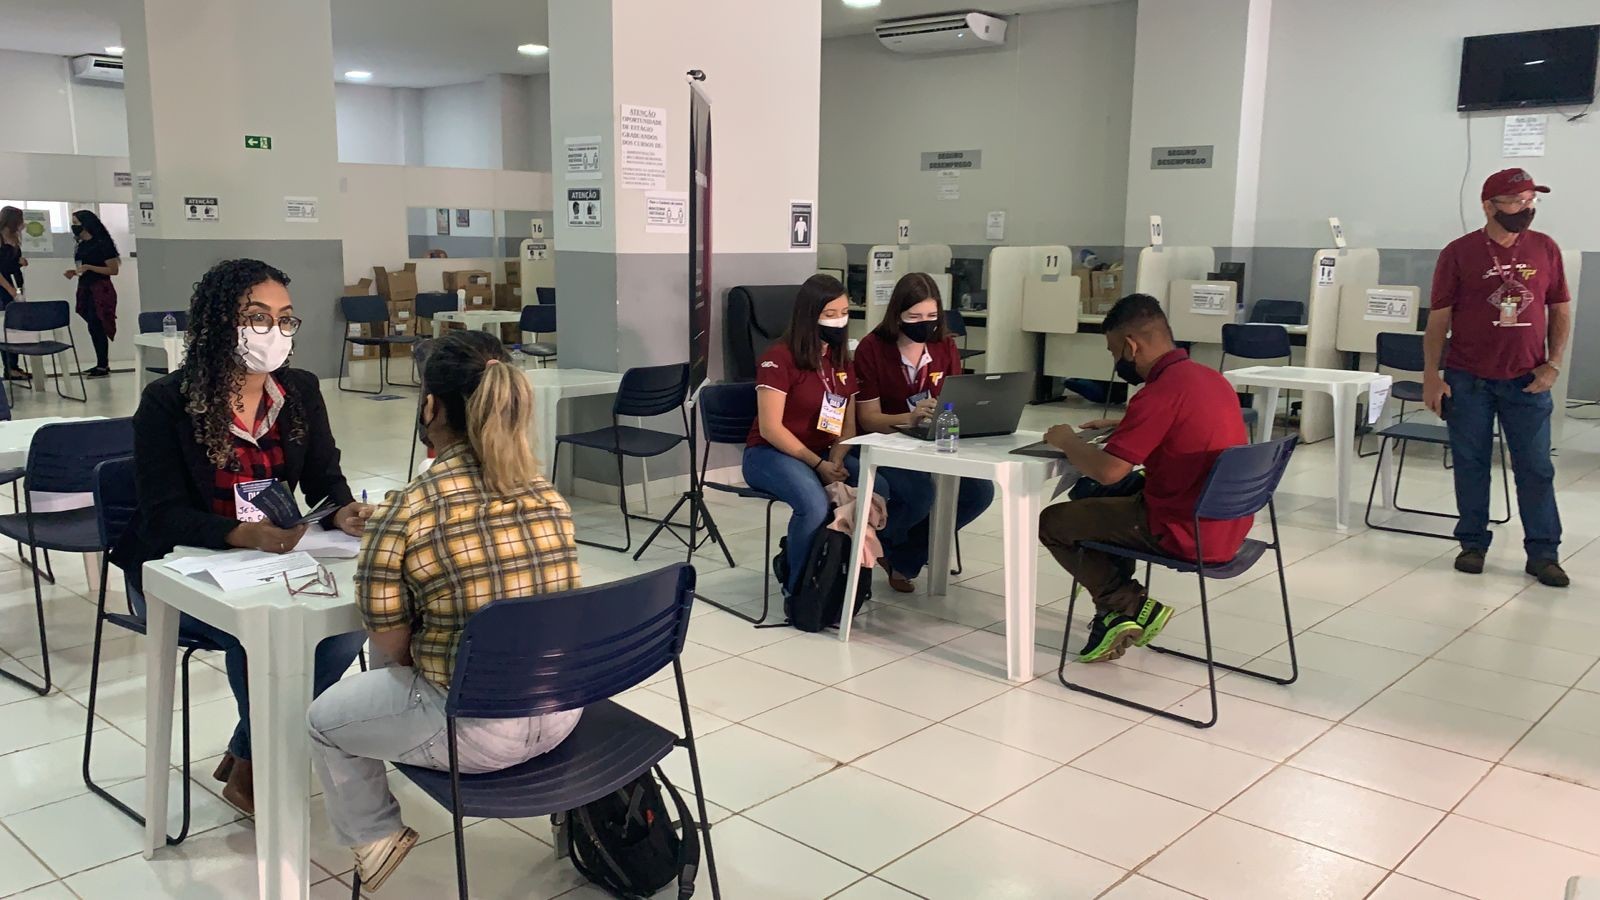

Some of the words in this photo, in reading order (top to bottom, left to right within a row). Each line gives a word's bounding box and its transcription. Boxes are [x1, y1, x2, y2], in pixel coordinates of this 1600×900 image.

[629, 108, 657, 118] ATENÇÃO
[622, 116, 662, 126] OPORTUNIDADE
[571, 191, 597, 200] ATENÇÃO
[533, 224, 543, 233] 16
[899, 225, 909, 237] 12
[1152, 223, 1161, 237] 10
[1046, 255, 1058, 267] 11
